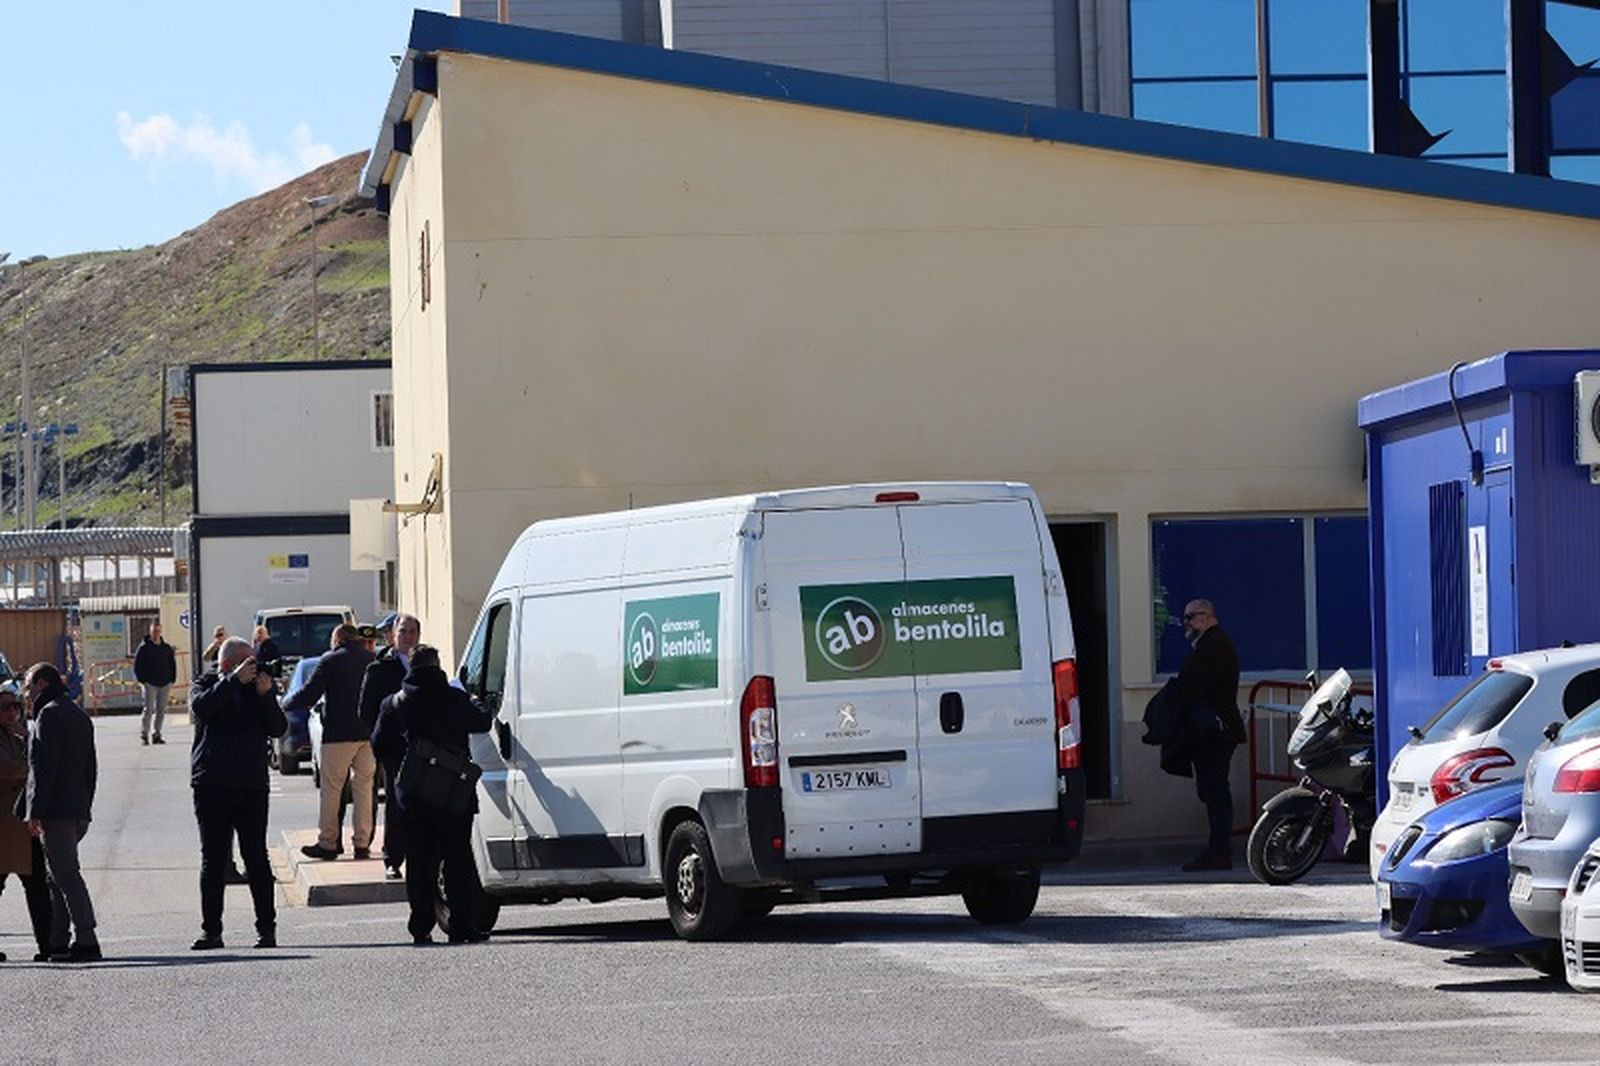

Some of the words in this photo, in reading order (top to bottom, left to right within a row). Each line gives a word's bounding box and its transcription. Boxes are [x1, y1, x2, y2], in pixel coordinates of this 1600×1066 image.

[892, 602, 975, 616] almacenes
[825, 610, 876, 655] ab
[894, 613, 1004, 642] bentolila
[632, 626, 655, 670] ab
[661, 630, 712, 656] bentolila
[815, 772, 852, 789] 2157
